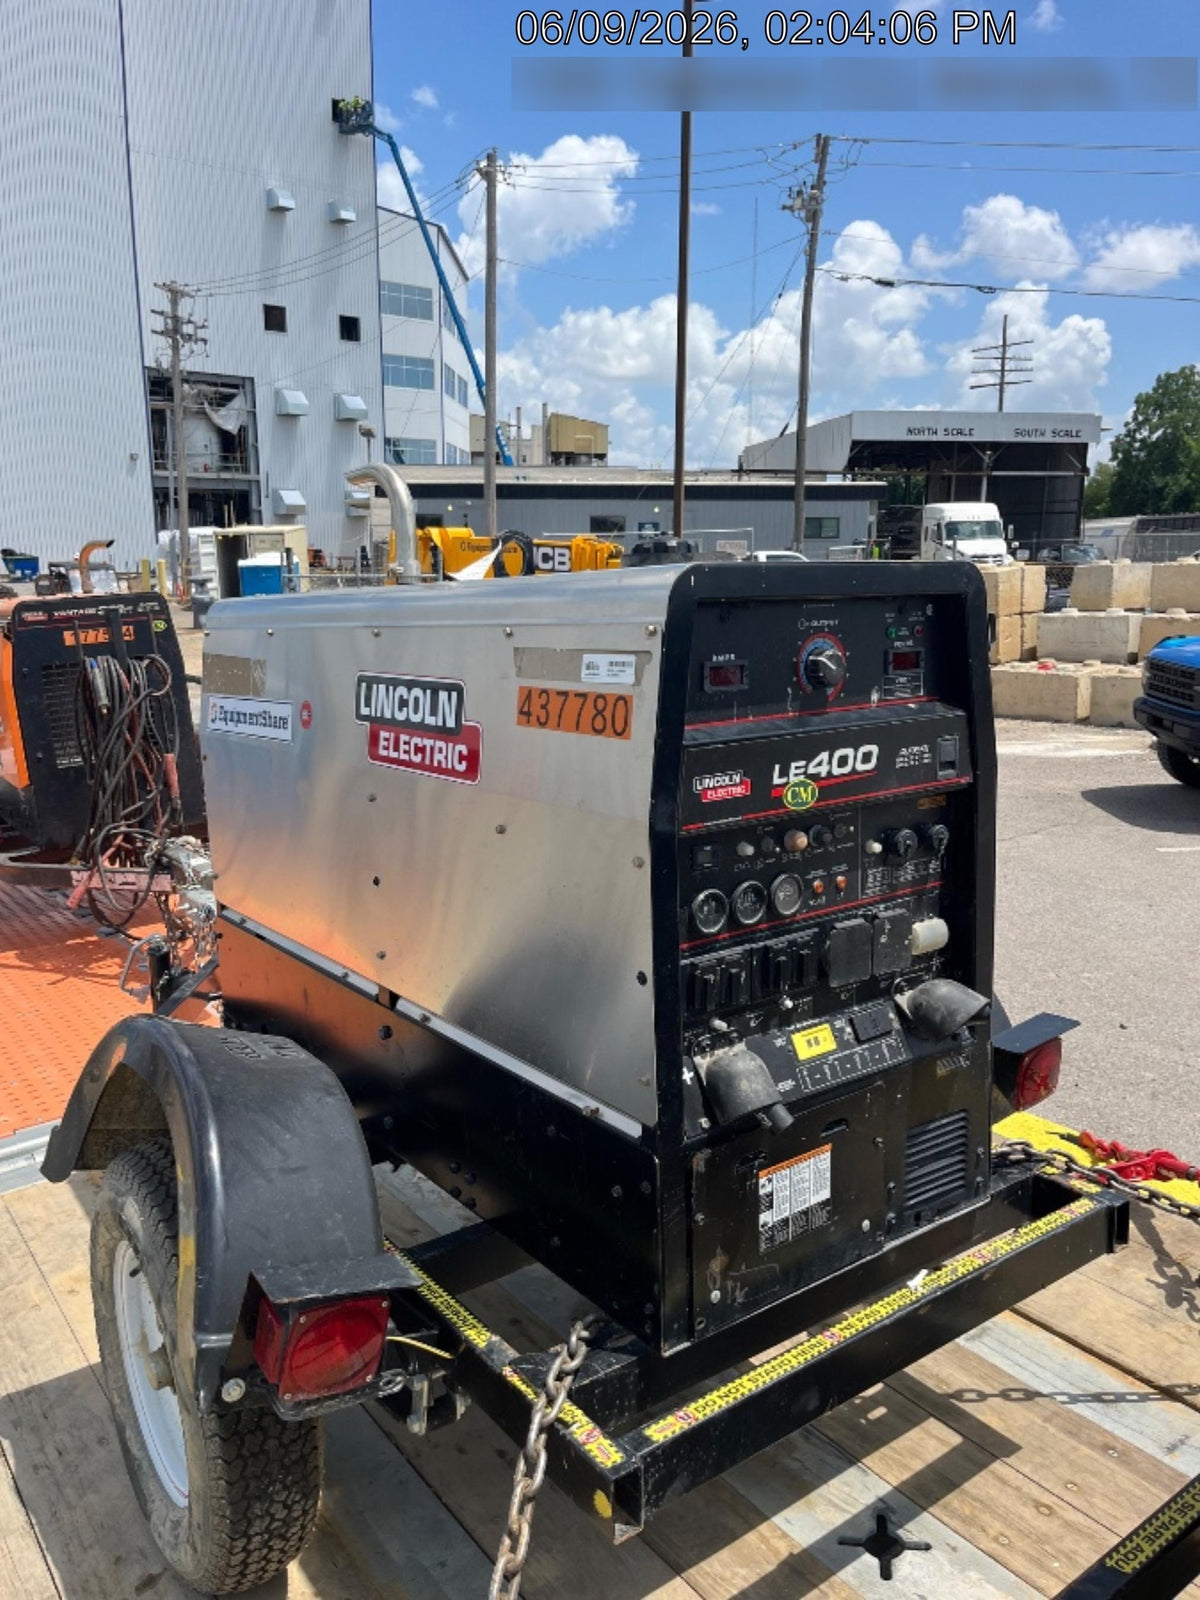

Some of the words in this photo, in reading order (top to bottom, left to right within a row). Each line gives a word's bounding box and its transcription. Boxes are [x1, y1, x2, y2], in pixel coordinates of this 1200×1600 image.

[906, 427, 938, 437] NORTH
[943, 427, 975, 437] SCALE
[1014, 428, 1046, 438] SOUTH
[1051, 428, 1082, 438] SCALE
[535, 547, 570, 571] CB
[218, 704, 289, 730] EquipmentShare
[360, 682, 458, 728] LINCOLN
[518, 688, 630, 738] 437780
[378, 730, 468, 772] ELECTRIC
[772, 744, 879, 785] LE400
[696, 773, 741, 790] LINCOLN
[707, 785, 746, 799] ELECTRIC
[787, 785, 814, 803] CM
[694, 1399, 717, 1414] DO
[717, 1382, 747, 1401] NOT
[747, 1357, 792, 1384] STAND
[792, 1338, 827, 1361] HERE
[1174, 1502, 1195, 1518] SE
[1141, 1516, 1178, 1547] PARE
